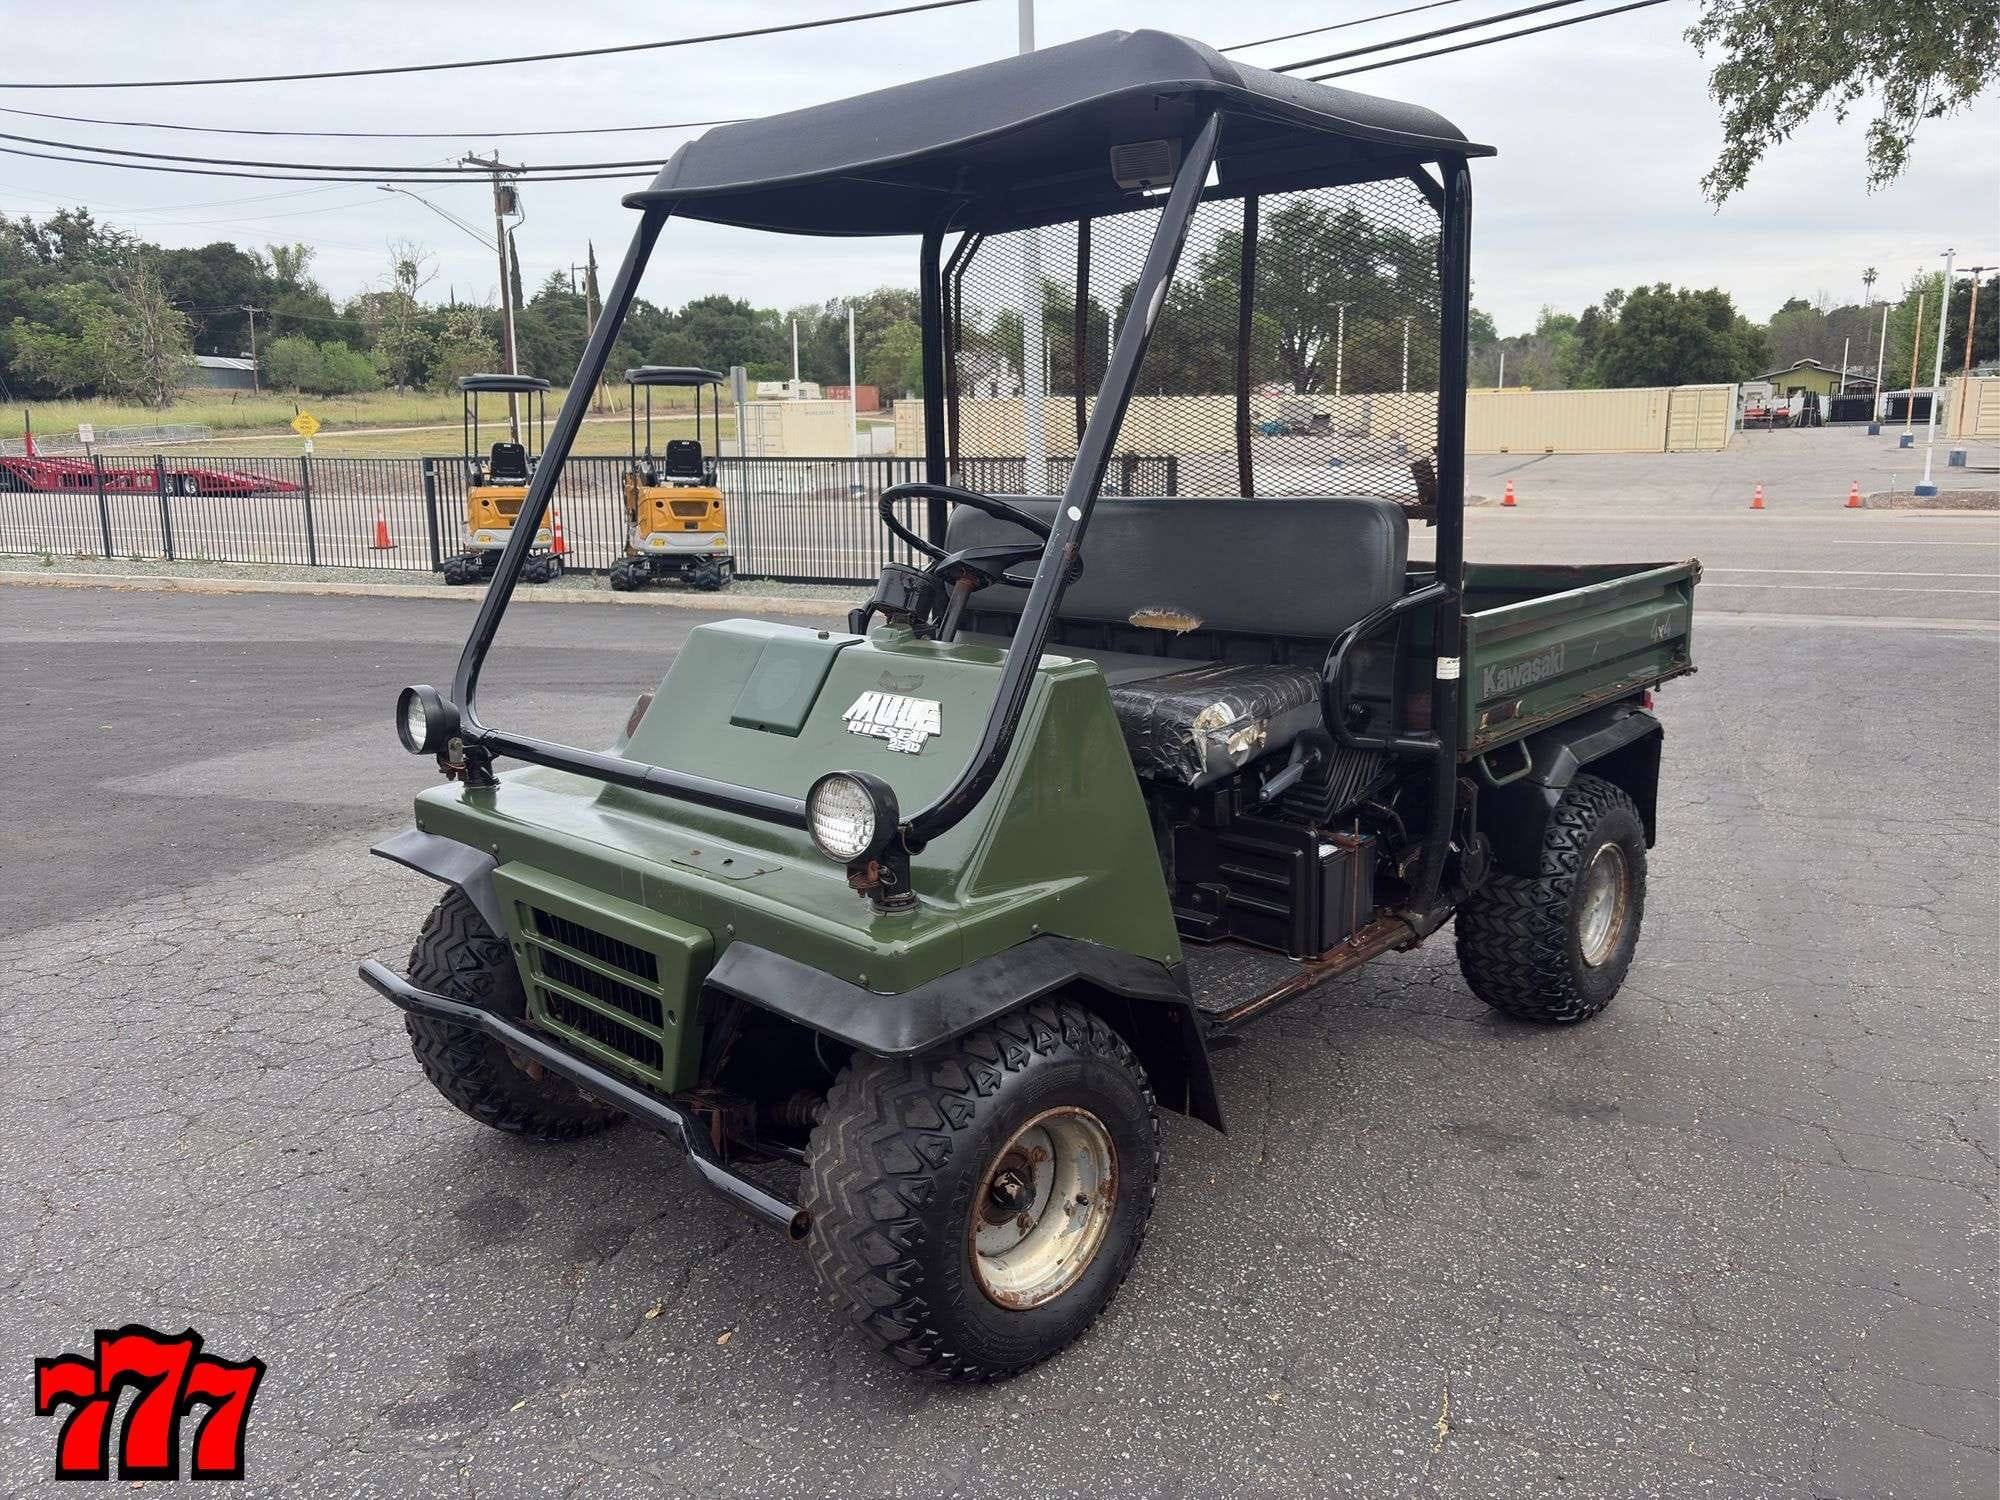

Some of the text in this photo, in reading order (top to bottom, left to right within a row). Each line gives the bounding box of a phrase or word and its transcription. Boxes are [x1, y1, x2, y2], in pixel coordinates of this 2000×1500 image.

[1482, 643, 1565, 699] Kawasaki
[841, 690, 942, 737] MULE
[846, 719, 929, 743] DIESEL
